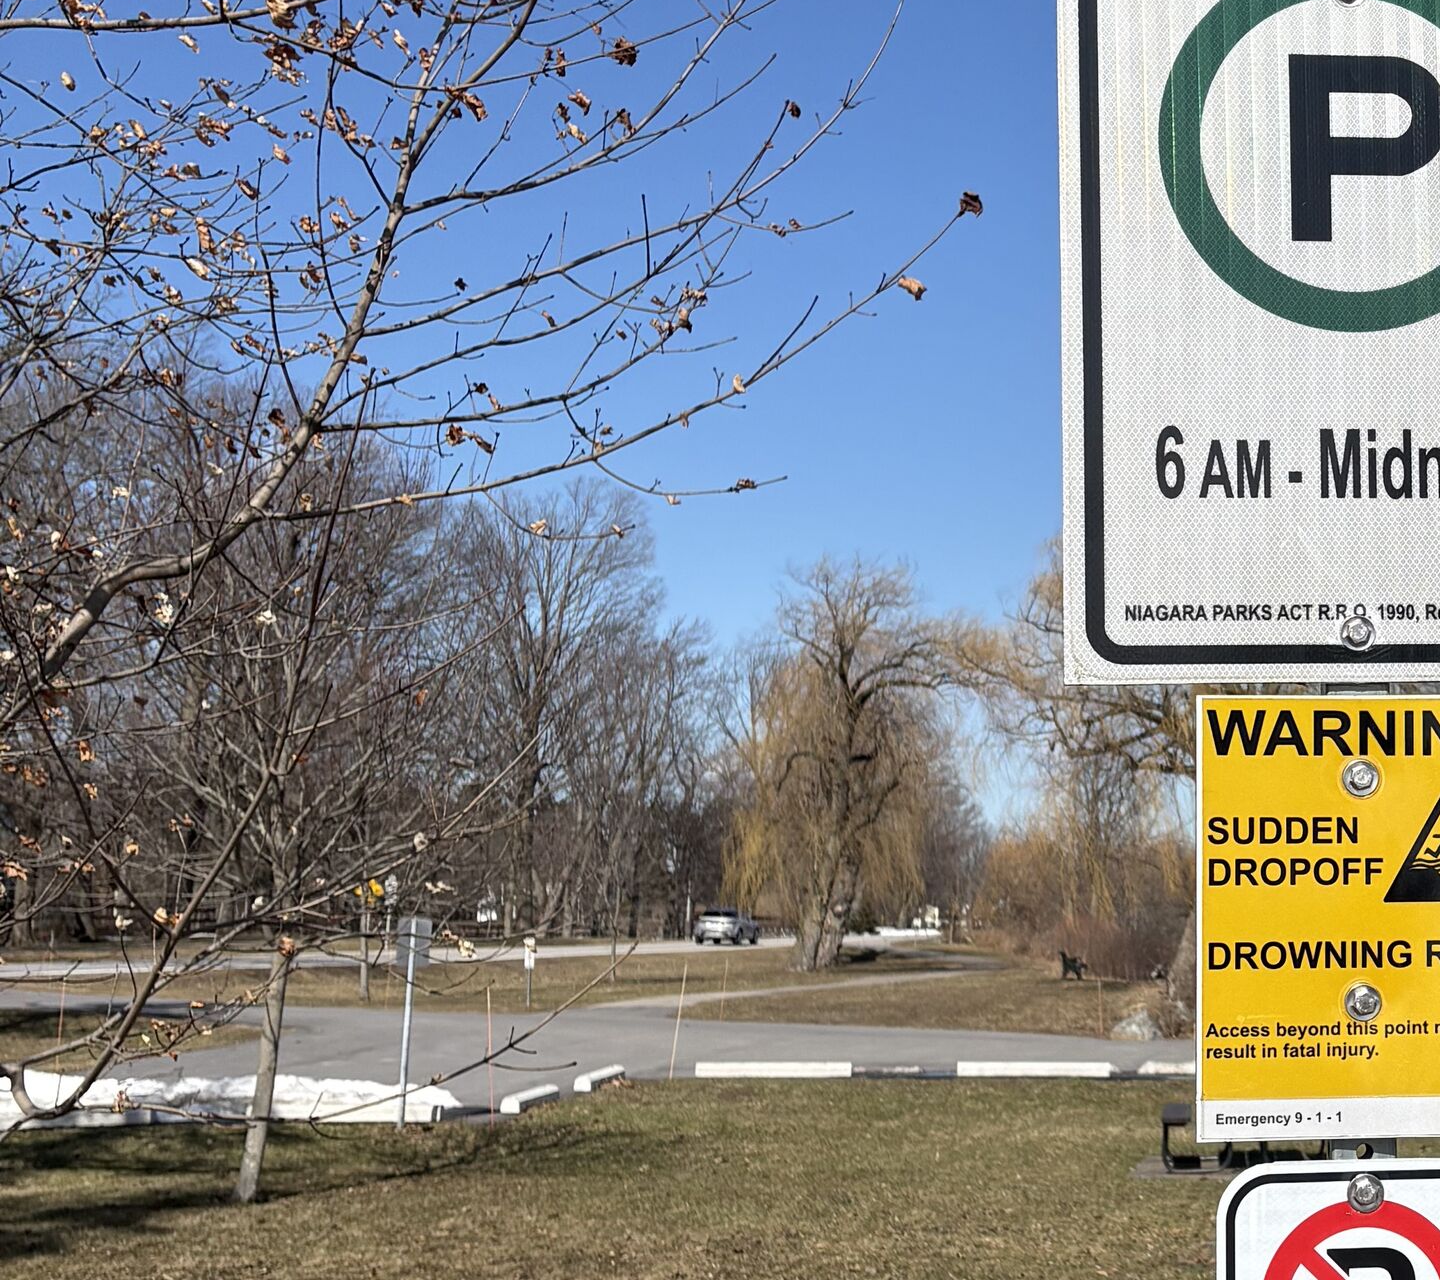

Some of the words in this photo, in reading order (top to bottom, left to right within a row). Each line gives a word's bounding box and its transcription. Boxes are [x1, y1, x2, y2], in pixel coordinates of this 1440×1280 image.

[1155, 425, 1186, 499] 6
[1199, 439, 1272, 499] AM
[1288, 470, 1302, 483] -
[1124, 604, 1207, 621] NIAGARA
[1212, 604, 1272, 621] PARKS
[1277, 604, 1313, 621] ACT
[1318, 603, 1372, 621] R.RO.
[1377, 604, 1420, 622] 1990,
[1207, 816, 1359, 845] SUDDEN
[1208, 857, 1383, 887] DROPOFF
[1208, 939, 1412, 971] DROWNING
[1206, 1022, 1270, 1038] Access
[1276, 1021, 1341, 1040] beyond
[1347, 1020, 1378, 1036] this
[1384, 1020, 1429, 1038] point
[1206, 1043, 1257, 1059] result
[1262, 1043, 1277, 1058] in
[1283, 1043, 1321, 1058] fatal
[1327, 1042, 1379, 1060] injury.
[1215, 1113, 1291, 1127] Emergency
